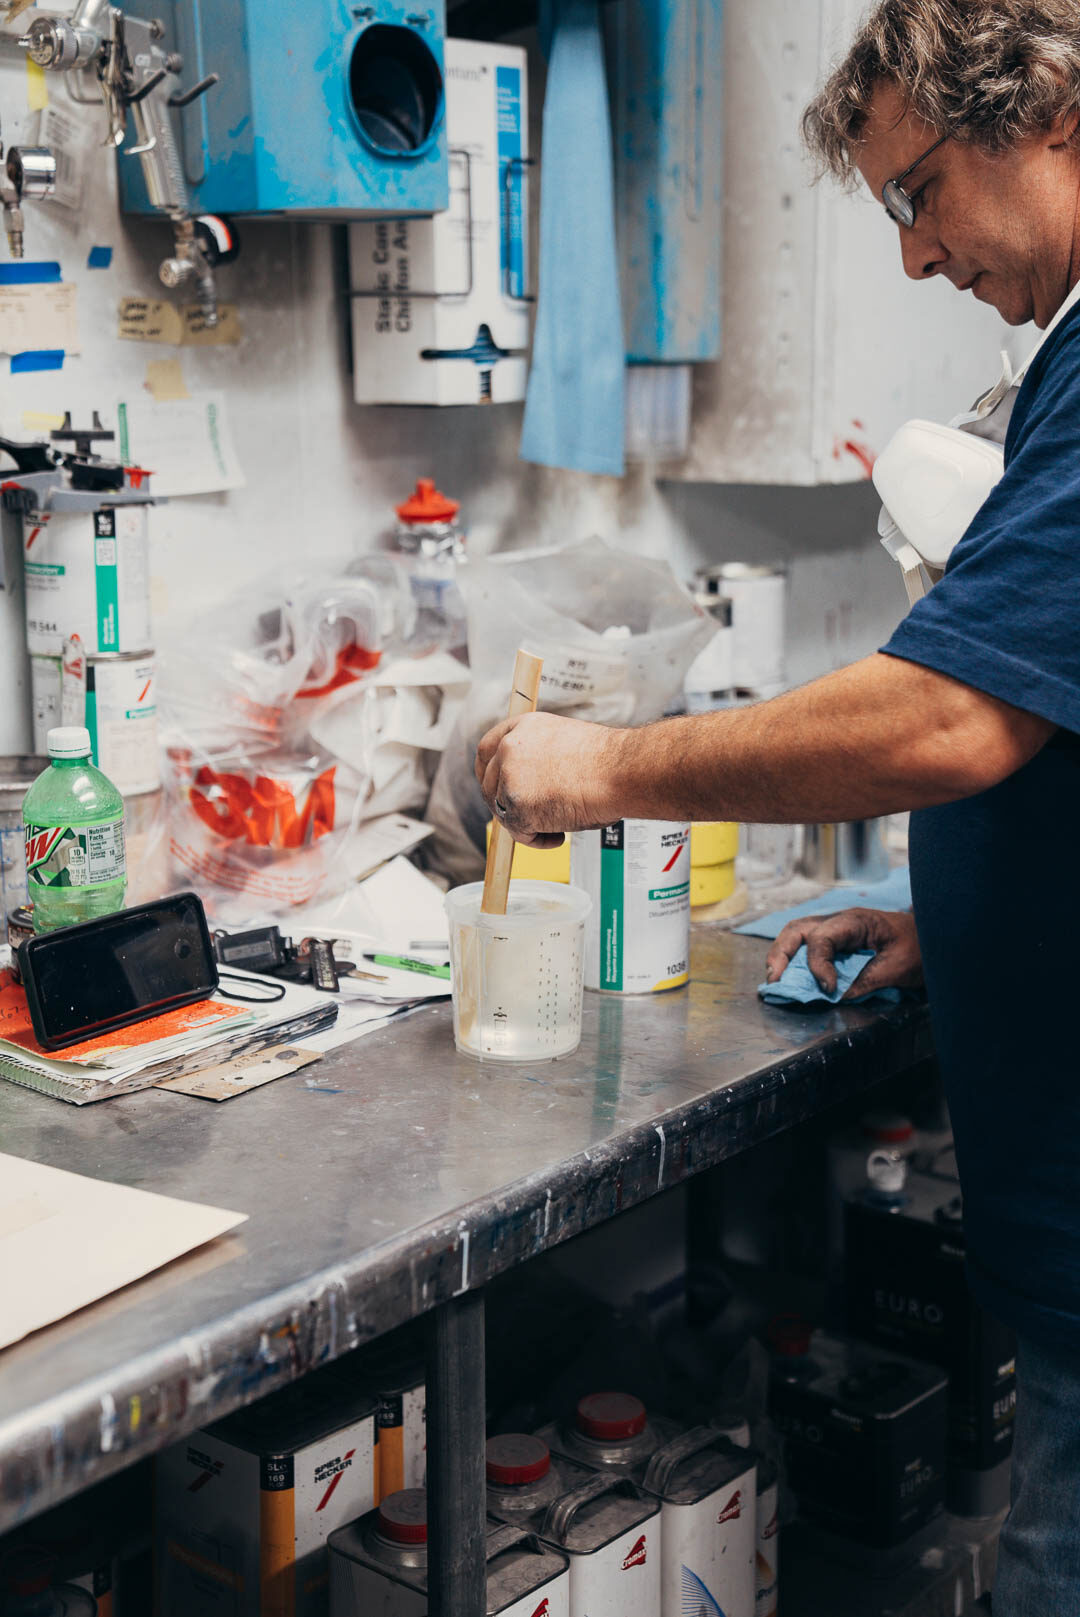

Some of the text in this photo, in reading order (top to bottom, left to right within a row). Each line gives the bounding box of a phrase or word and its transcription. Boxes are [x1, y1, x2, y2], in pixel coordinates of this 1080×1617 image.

[373, 272, 391, 333] Staic
[393, 257, 412, 333] Chifon
[89, 826, 111, 834] Nutrition
[661, 832, 683, 841] SPIES
[873, 1288, 944, 1325] EURO
[314, 1456, 341, 1475] SPIES
[314, 1459, 352, 1483] HECKER
[268, 1474, 285, 1482] 169
[621, 1548, 646, 1570] Cromax
